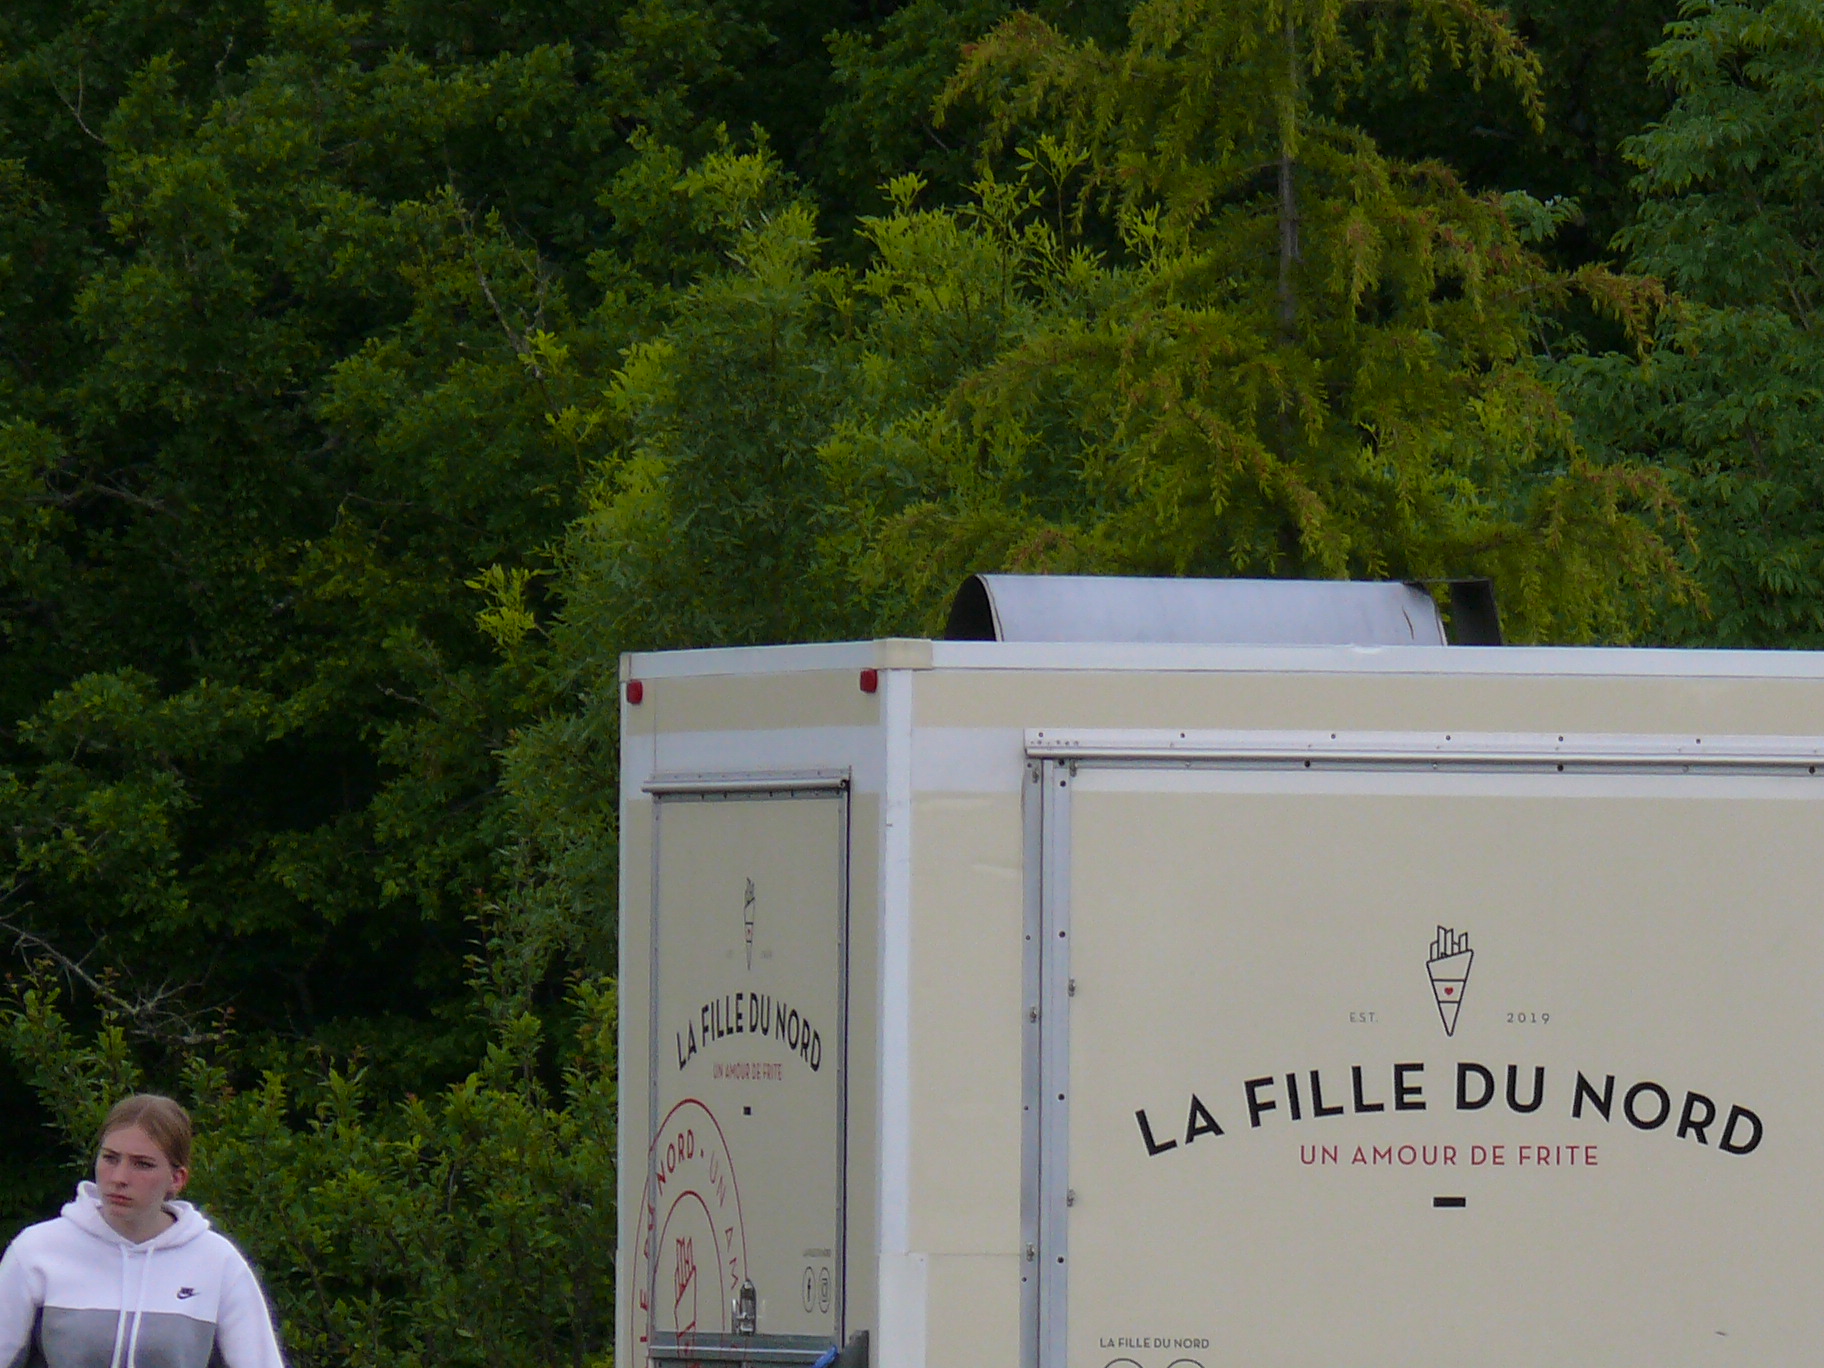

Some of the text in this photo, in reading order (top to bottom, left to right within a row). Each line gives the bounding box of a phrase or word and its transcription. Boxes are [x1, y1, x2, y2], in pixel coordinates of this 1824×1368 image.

[1349, 1012, 1550, 1024] EST. 2019
[677, 992, 822, 1072] LA FILLE DU NORD
[725, 1063, 750, 1081] AMOUR
[763, 1064, 782, 1081] FRITE
[1135, 1062, 1763, 1157] LA FILLE DU NORD
[656, 1129, 694, 1197] NORD
[1300, 1145, 1599, 1166] UN AMOUR DE FRITE
[1100, 1338, 1209, 1349] LA FILLE DU NORD
